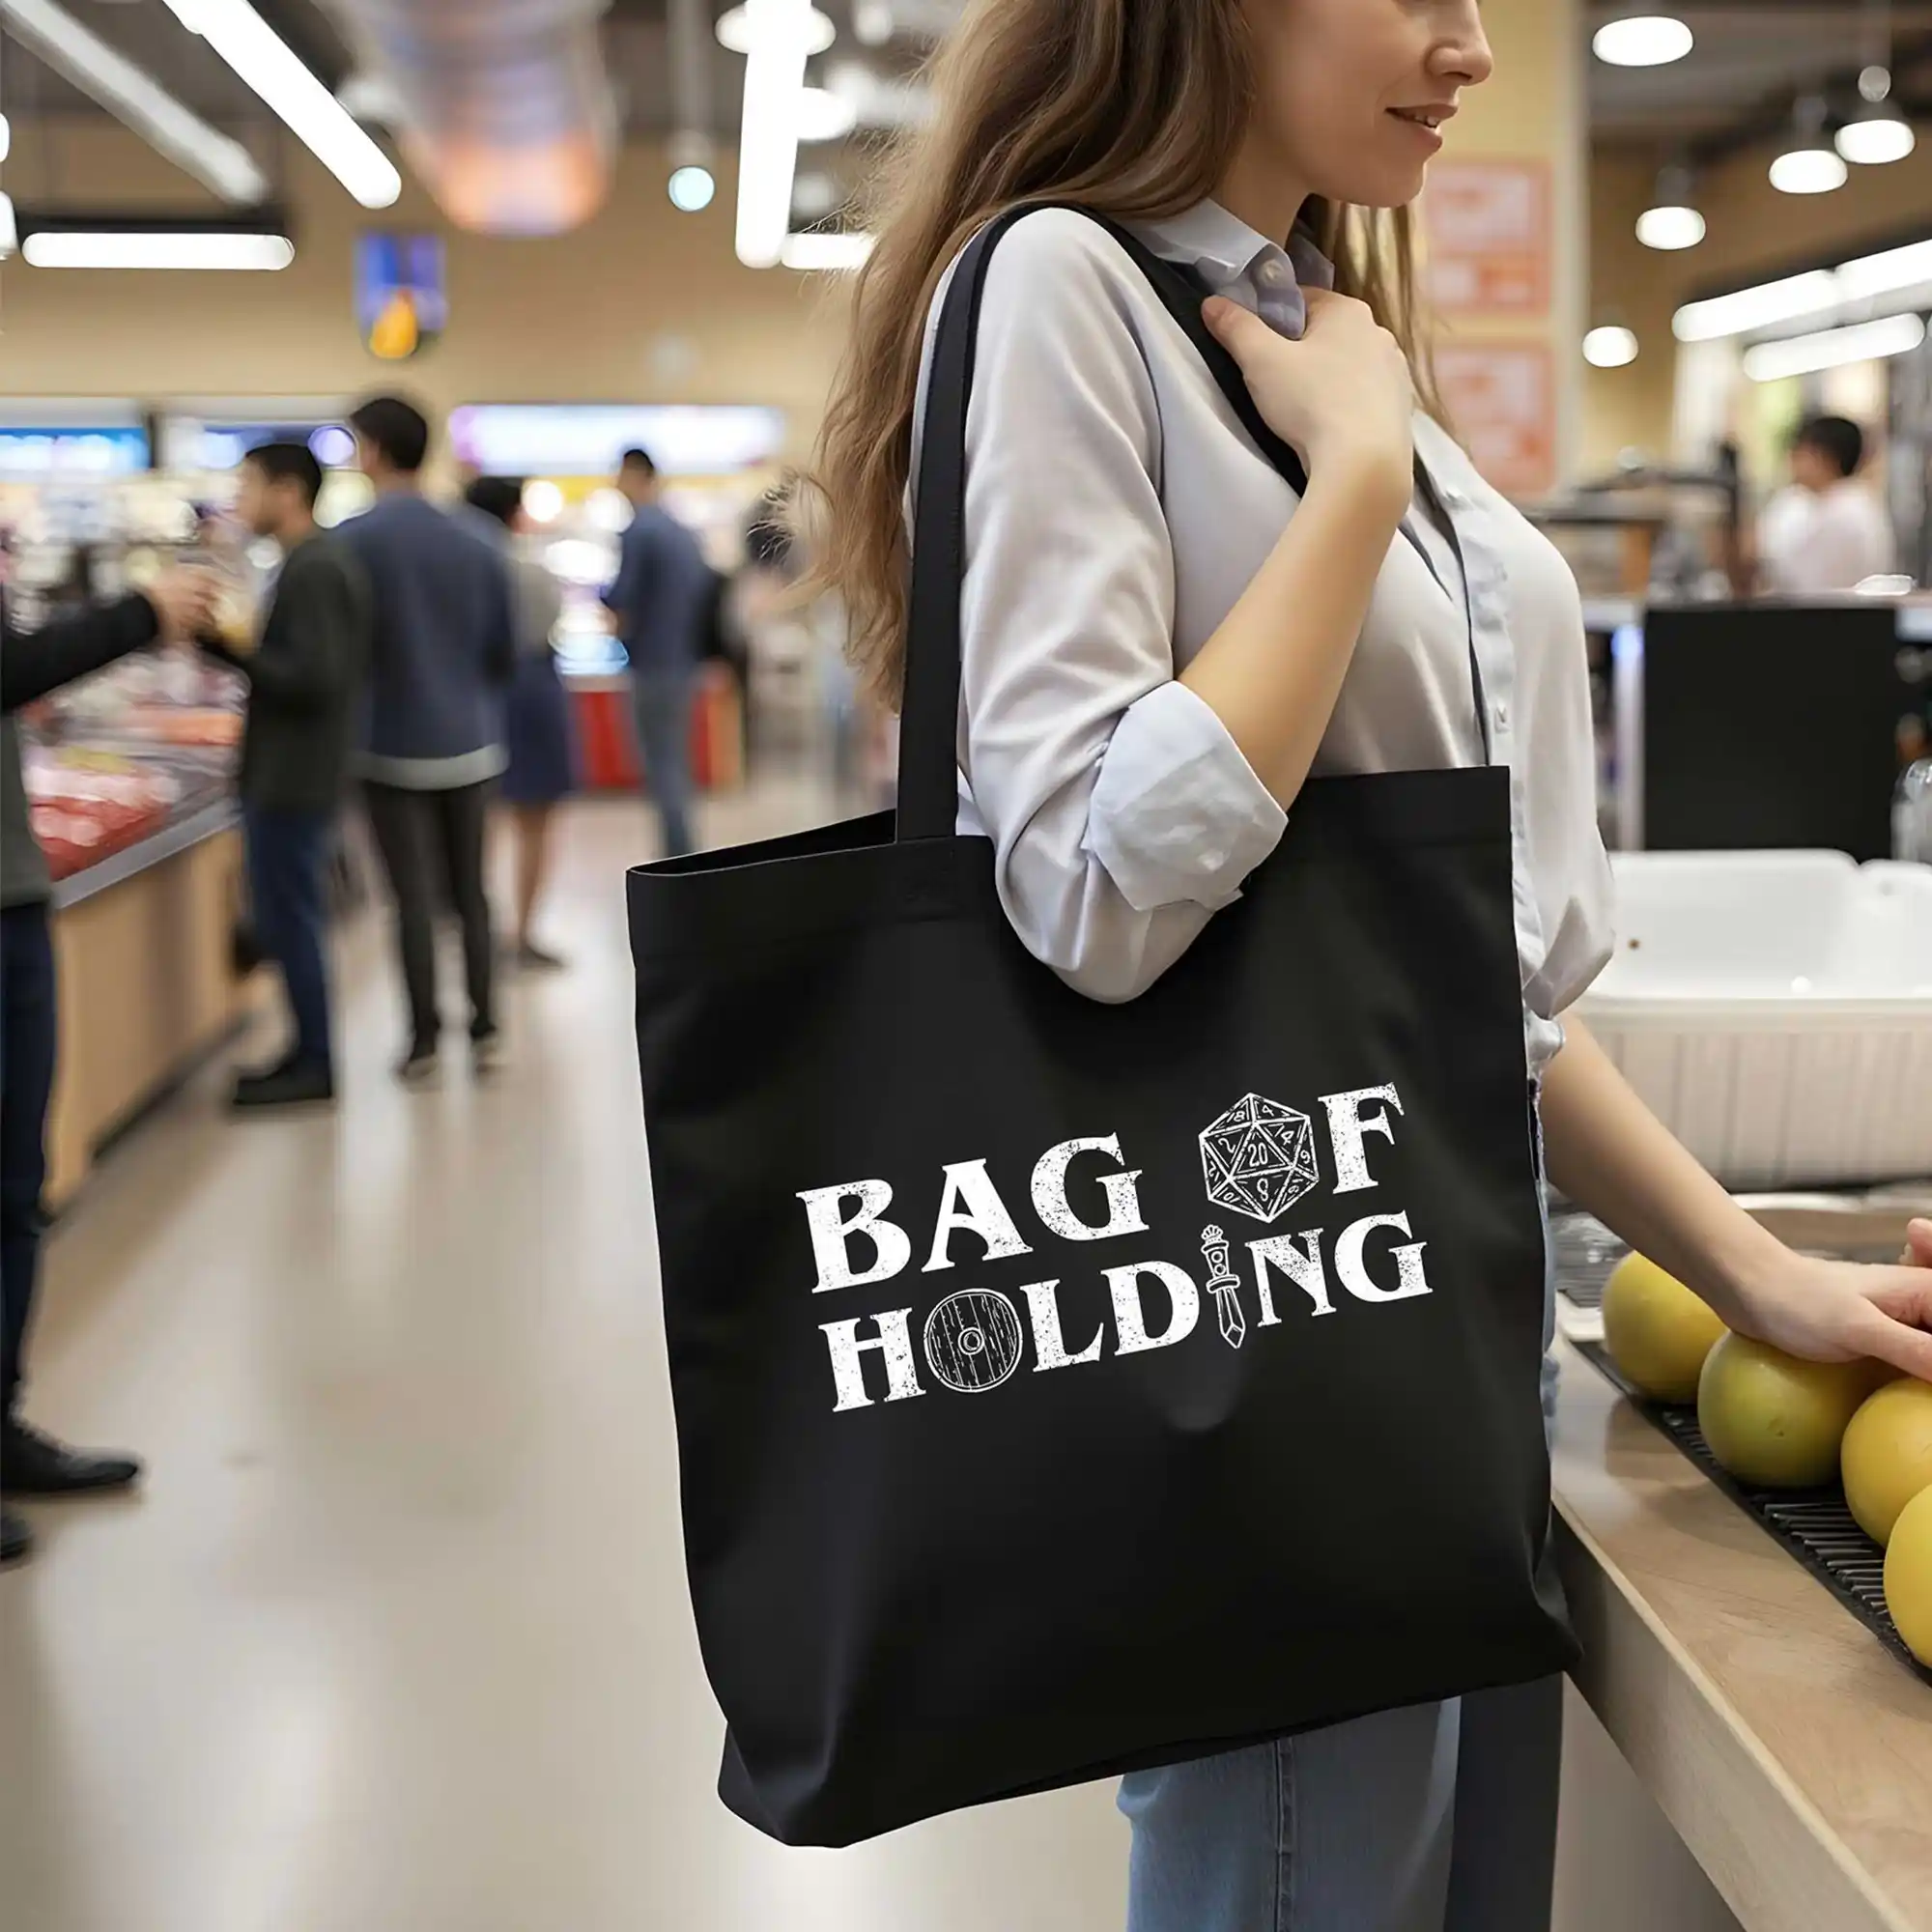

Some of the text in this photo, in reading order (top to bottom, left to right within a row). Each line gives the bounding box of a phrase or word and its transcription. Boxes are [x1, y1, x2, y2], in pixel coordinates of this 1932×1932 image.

[1247, 1142, 1268, 1168] 20
[1256, 1177, 1269, 1203] 8
[796, 1131, 1150, 1293] BAG
[817, 1208, 1434, 1413] HOLDING
